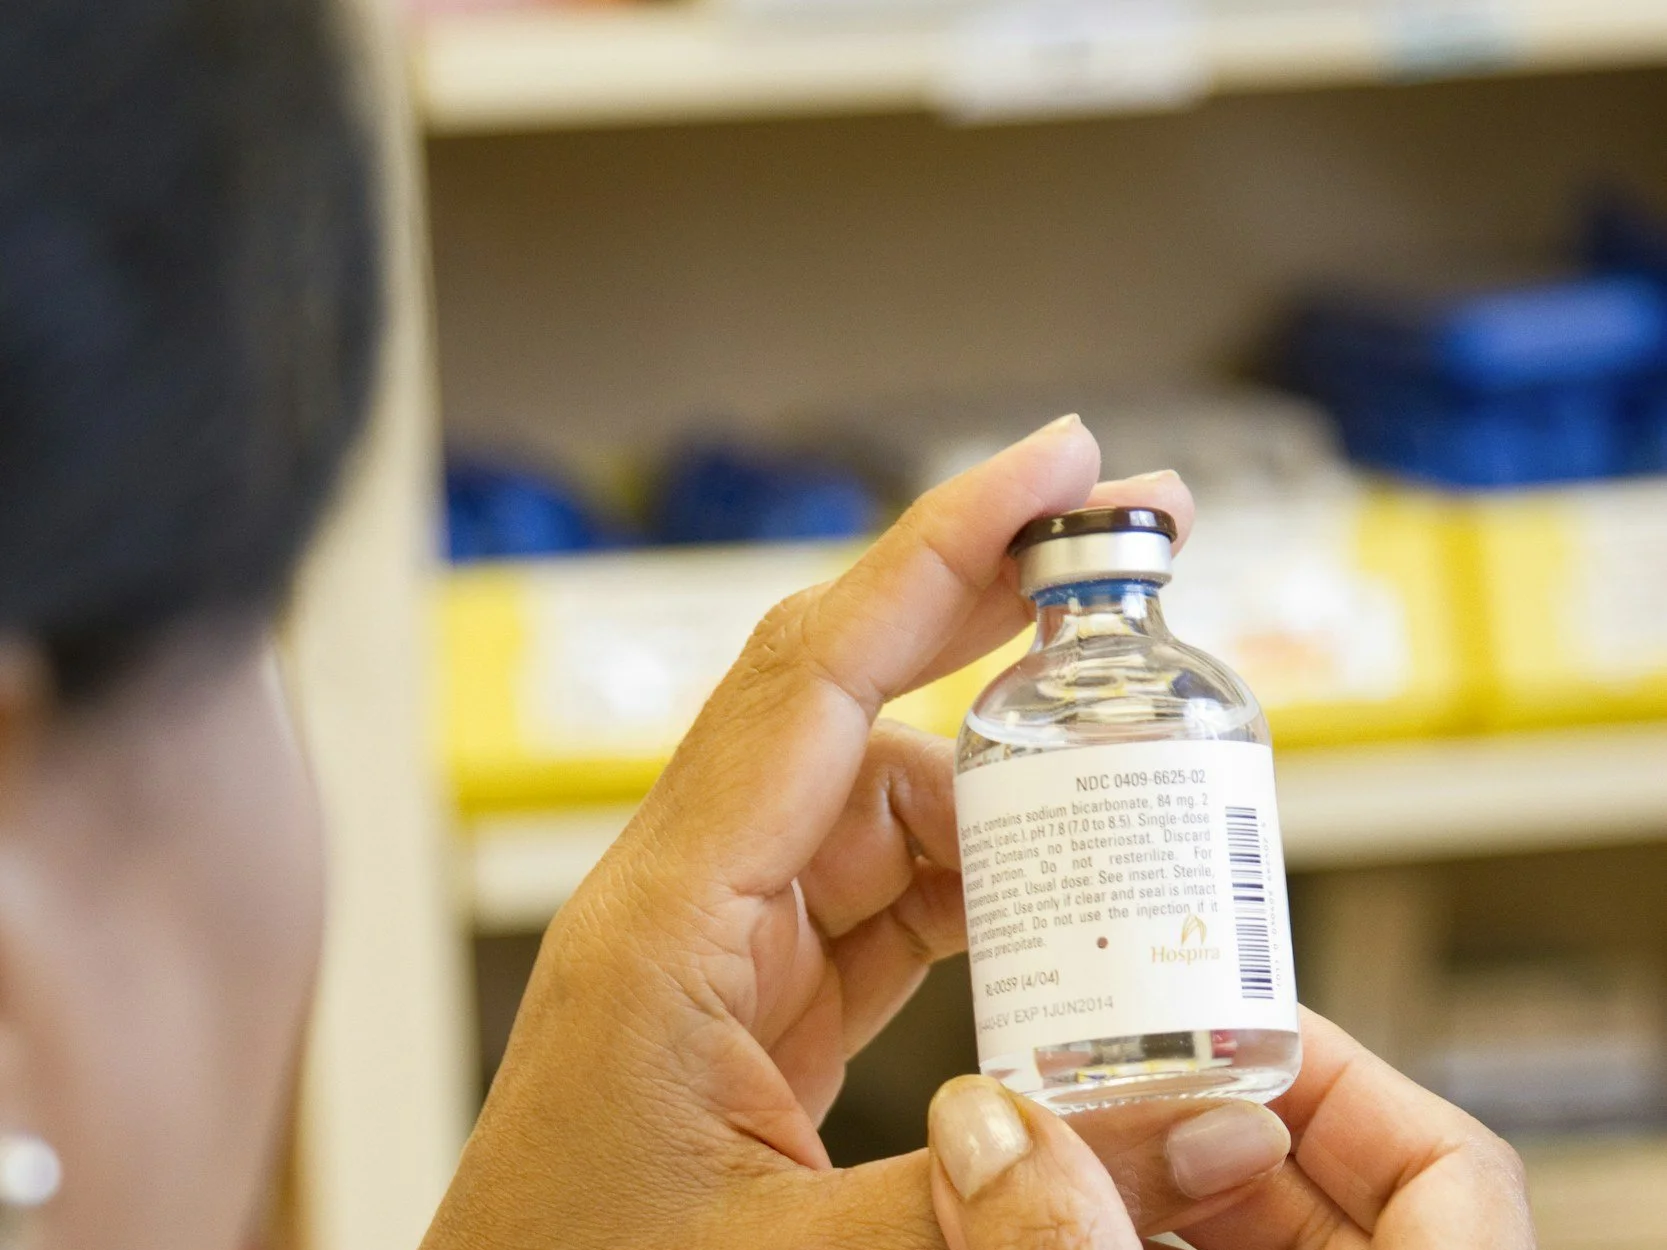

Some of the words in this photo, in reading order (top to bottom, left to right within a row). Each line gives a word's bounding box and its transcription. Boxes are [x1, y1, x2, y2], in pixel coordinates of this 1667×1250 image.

[1076, 774, 1110, 792] NDC
[1114, 769, 1206, 788] 0409-6625-02
[1026, 805, 1067, 823] sodium
[1157, 793, 1171, 807] 84
[1031, 825, 1046, 842] pH
[1068, 818, 1090, 835] (7.0
[1092, 819, 1105, 831] to
[1138, 812, 1210, 828] Single-dose
[995, 847, 1040, 865] Contains
[1047, 843, 1063, 856] no
[1071, 832, 1154, 851] bacteriostat.
[1164, 828, 1211, 844] Discard
[1040, 860, 1057, 874] Do
[1072, 856, 1093, 870] not
[1194, 846, 1213, 859] For
[1025, 878, 1056, 895] Usual
[1099, 870, 1124, 885] See
[1128, 868, 1168, 882] insert.
[1013, 901, 1034, 915] Use
[1037, 895, 1060, 911] only
[1063, 892, 1071, 907] if
[1075, 891, 1106, 906] clear
[1111, 886, 1134, 901] and
[1139, 885, 1165, 899] seal
[1169, 885, 1179, 896] is
[1183, 883, 1217, 896] intact
[1032, 916, 1048, 930] Do
[1054, 913, 1073, 926] not
[1080, 911, 1101, 923] use
[1108, 906, 1129, 920] the
[1136, 902, 1190, 919] injection
[1197, 900, 1204, 913] if
[1211, 900, 1218, 912] it
[1150, 945, 1220, 966] Hospira
[1021, 969, 1059, 990] (4/04)
[1014, 1006, 1039, 1023] EXP
[1042, 995, 1114, 1018] 1JUN2014
